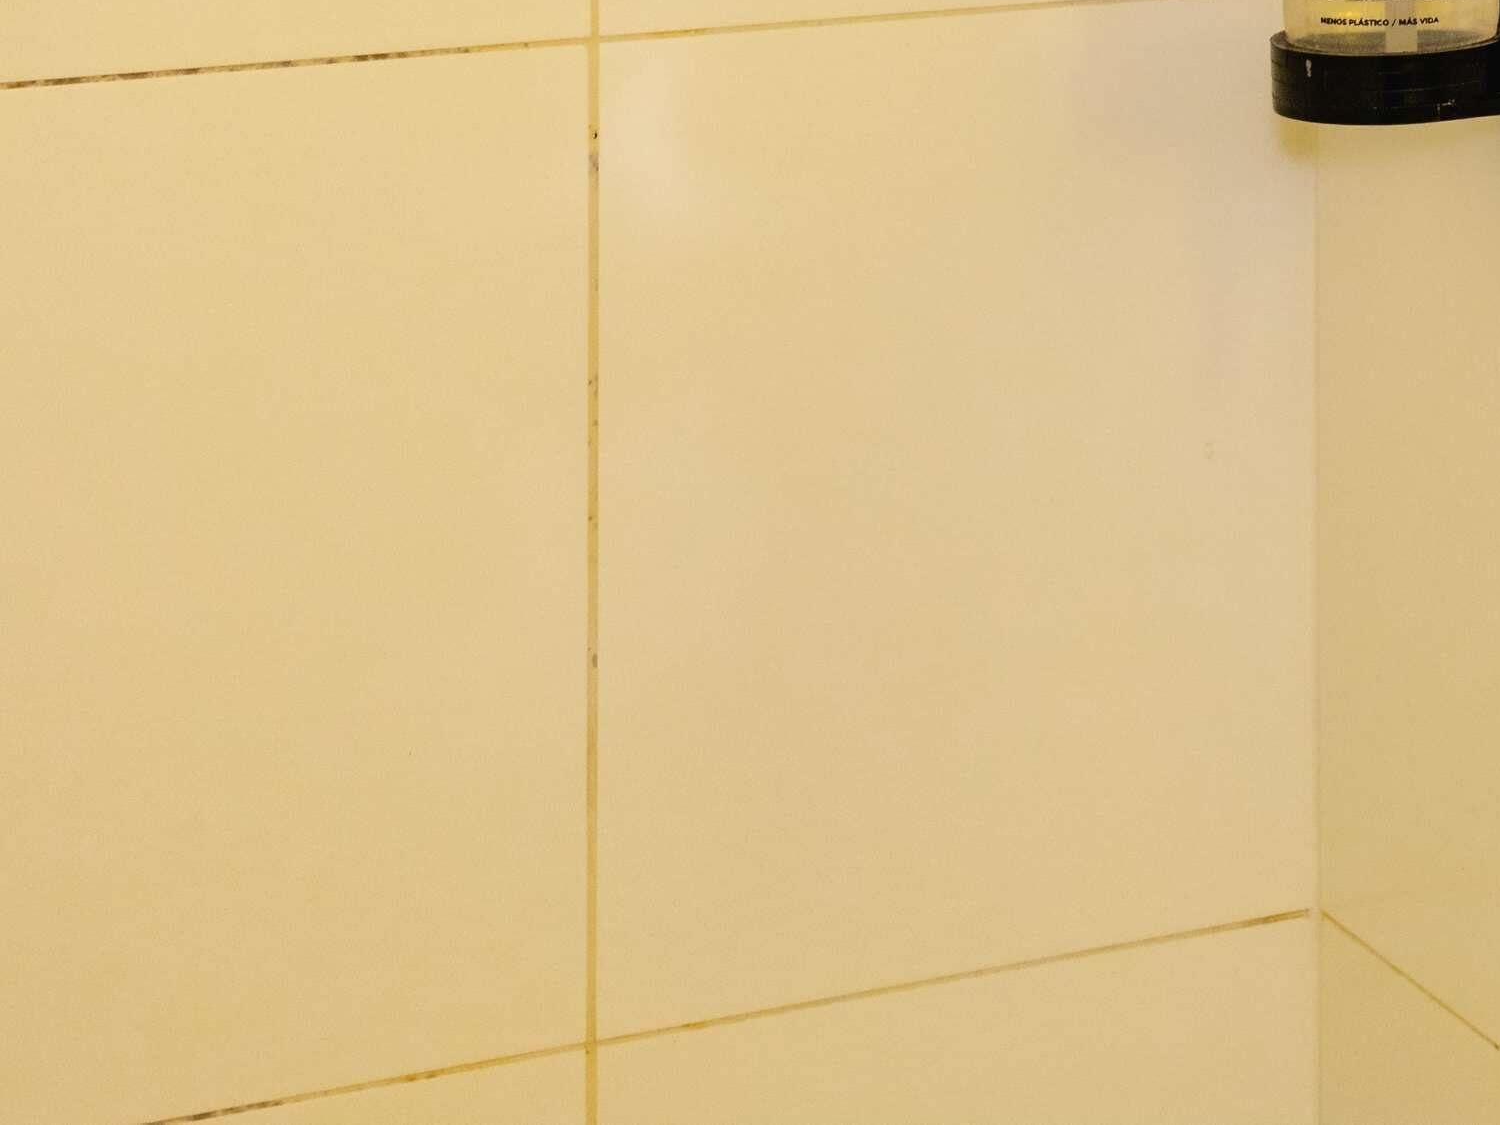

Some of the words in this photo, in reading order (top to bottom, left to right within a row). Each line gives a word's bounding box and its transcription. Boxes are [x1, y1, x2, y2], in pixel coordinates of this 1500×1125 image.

[1320, 17, 1347, 26] MENOS
[1348, 17, 1389, 27] PLÁSTICO
[1399, 17, 1417, 26] MÁS
[1420, 17, 1439, 25] VIDA
